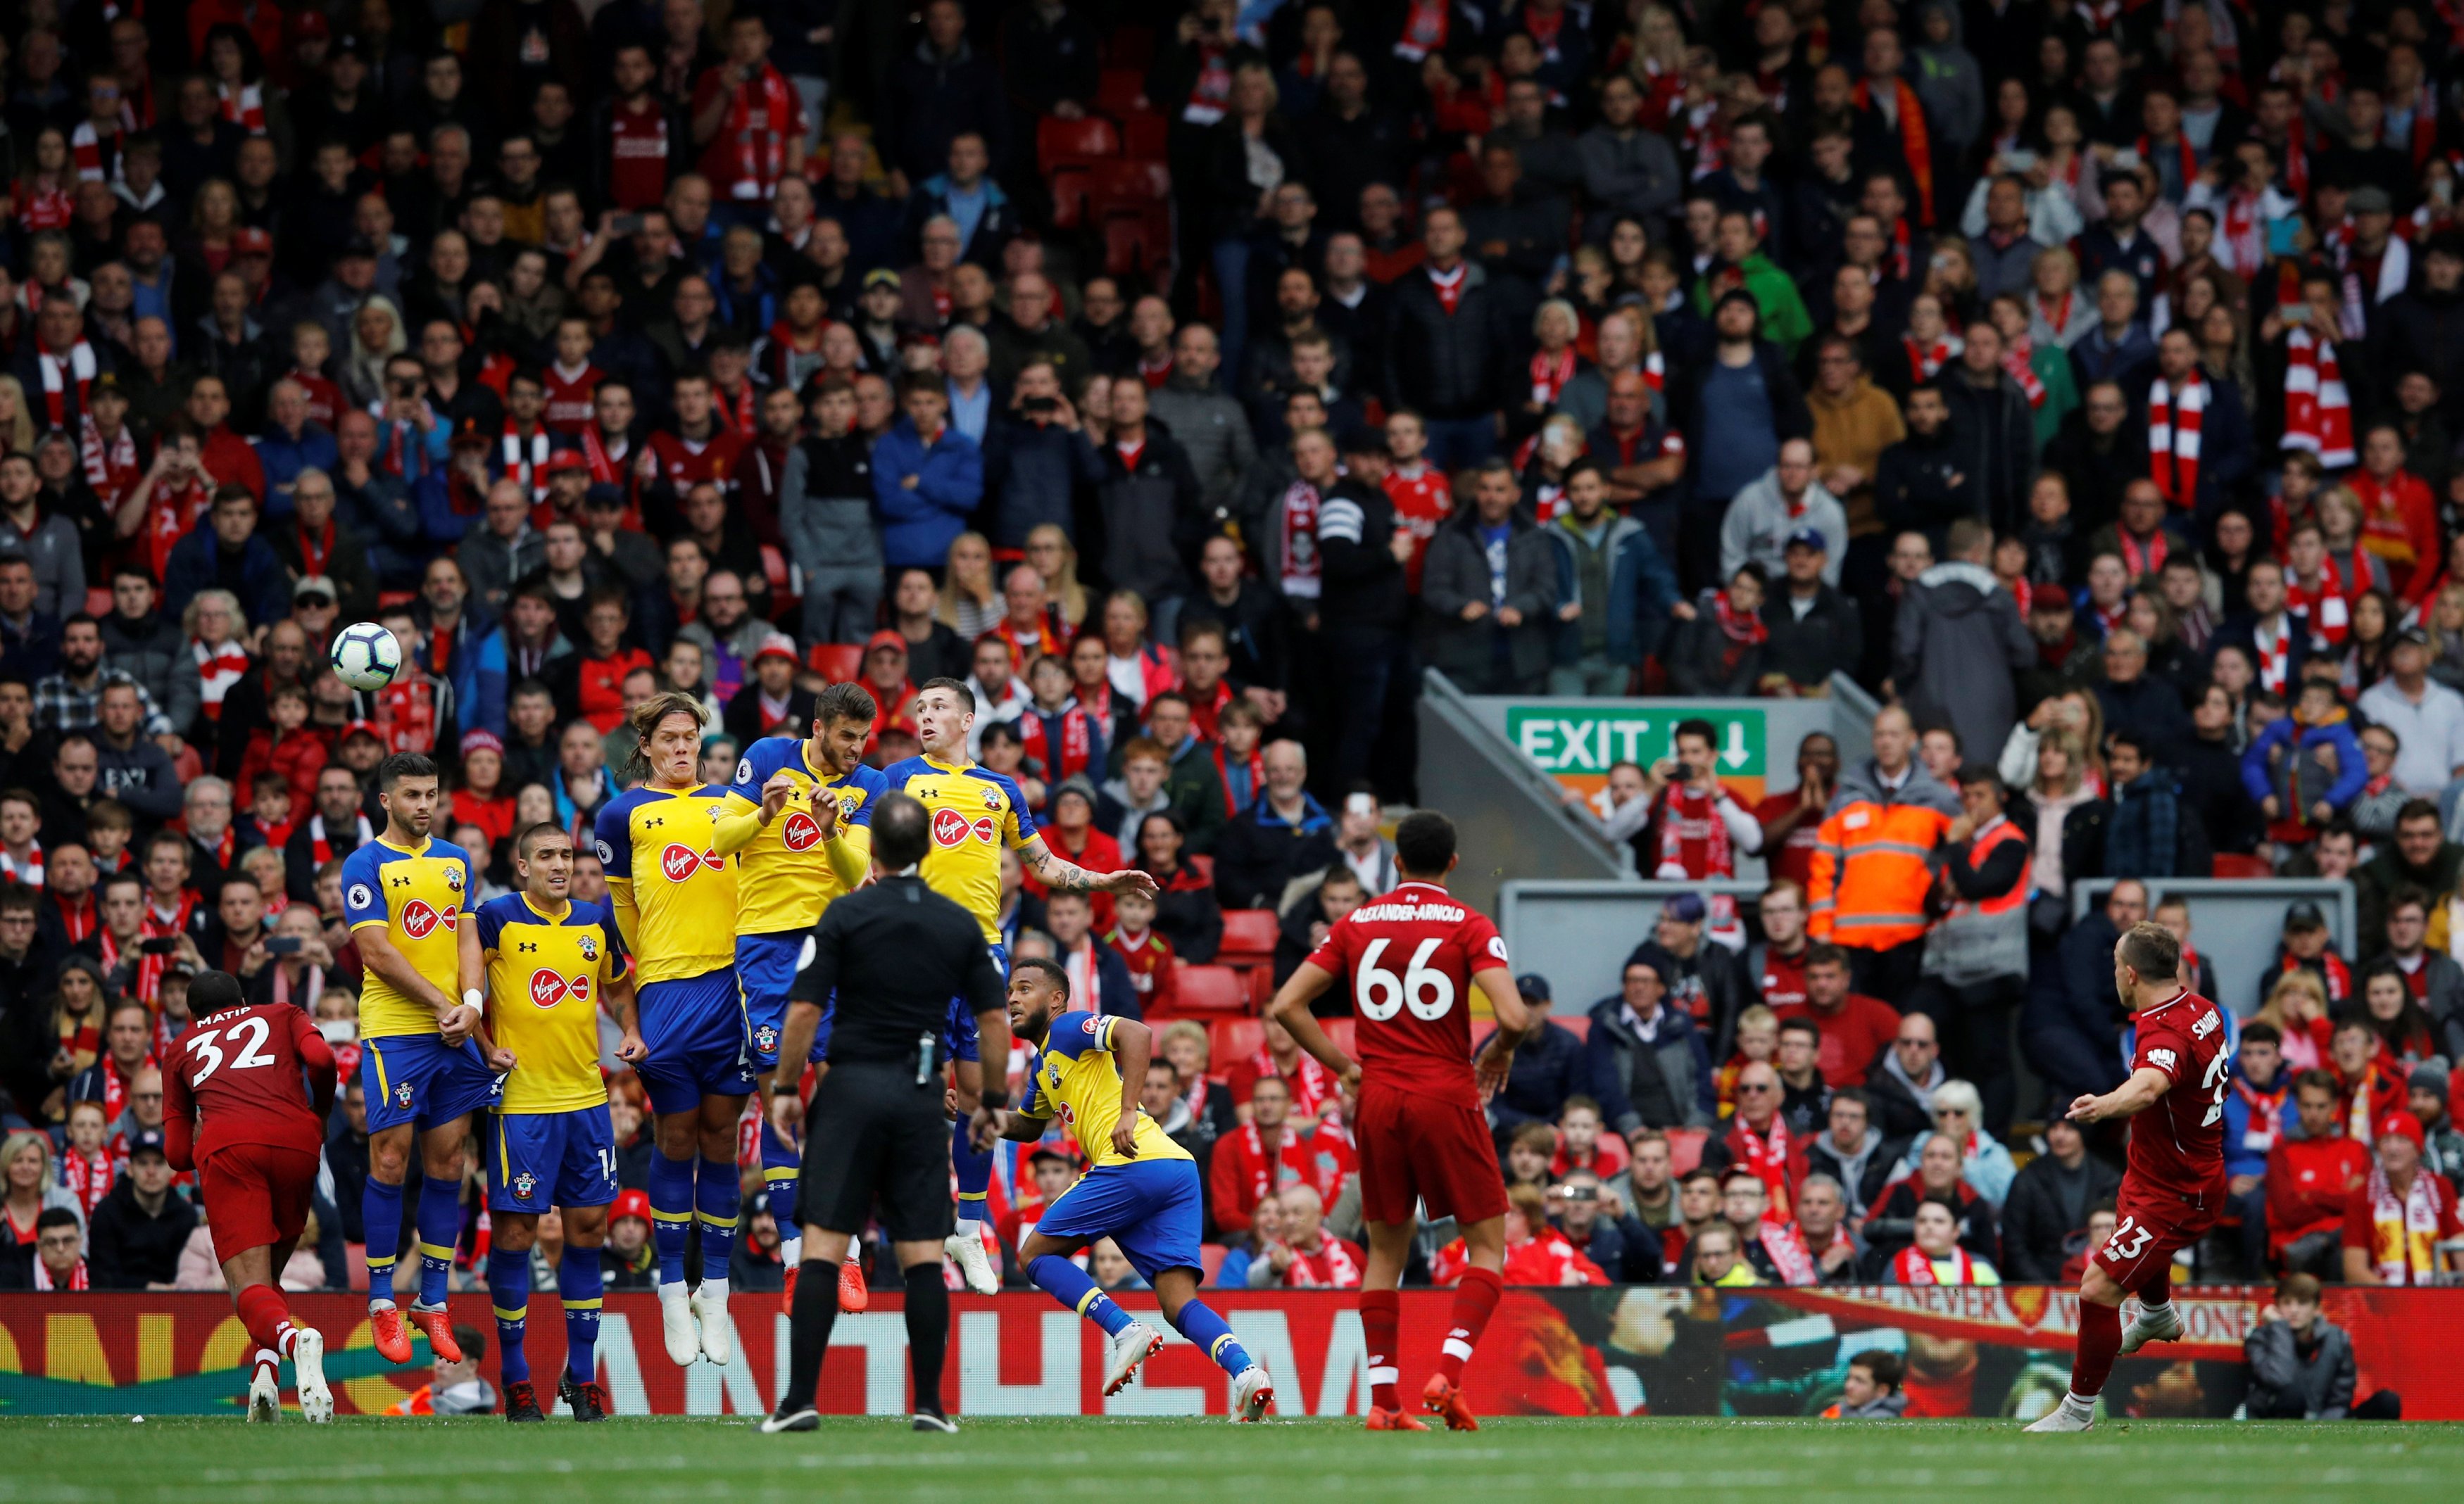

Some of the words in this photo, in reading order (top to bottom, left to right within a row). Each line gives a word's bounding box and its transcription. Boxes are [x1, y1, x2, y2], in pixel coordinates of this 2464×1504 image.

[1520, 719, 1649, 769] EXIT
[788, 819, 816, 846] Virgin
[937, 814, 964, 840] Virgin
[666, 849, 693, 875] Virgin
[407, 906, 432, 932] Virgin
[1349, 904, 1466, 923] ALEXANDER-ARNOLD
[534, 975, 562, 1001] Virgin
[1356, 937, 1454, 1021] 66
[196, 1006, 251, 1029] MATIP
[186, 1016, 275, 1088] 32
[598, 1145, 617, 1181] 14
[2109, 1215, 2154, 1259] 23
[551, 1310, 1366, 1416] ANTHEM
